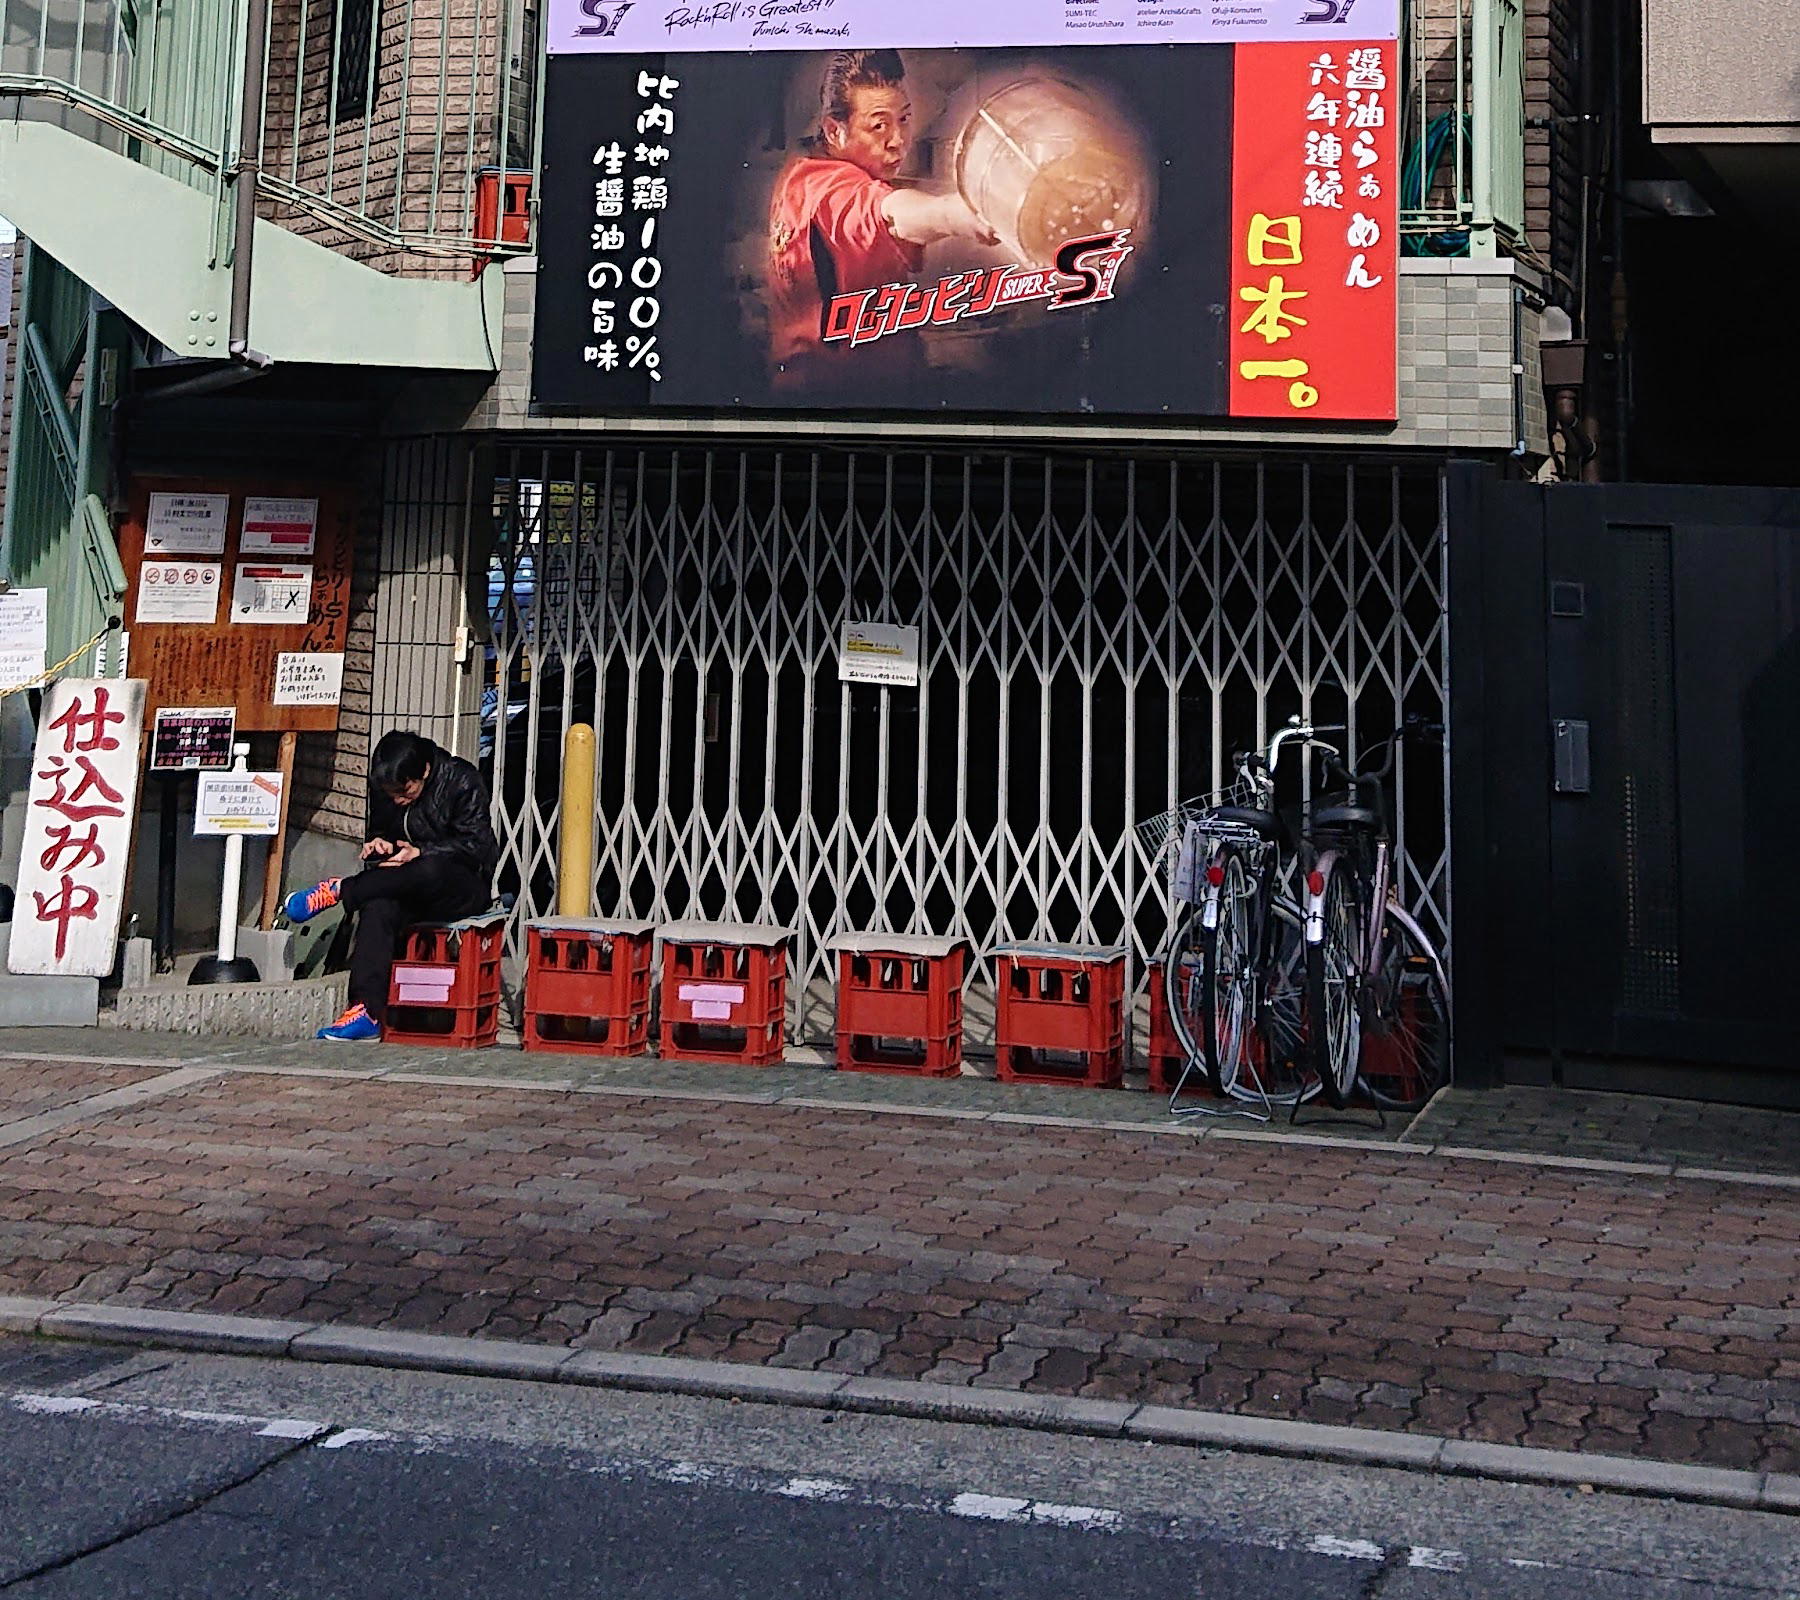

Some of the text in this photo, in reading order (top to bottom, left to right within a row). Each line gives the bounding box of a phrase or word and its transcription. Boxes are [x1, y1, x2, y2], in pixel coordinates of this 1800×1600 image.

[741, 5, 756, 18] is
[1302, 52, 1344, 210] 六年連続
[1002, 275, 1043, 300] SUPER
[33, 686, 126, 964] 仕込み中
